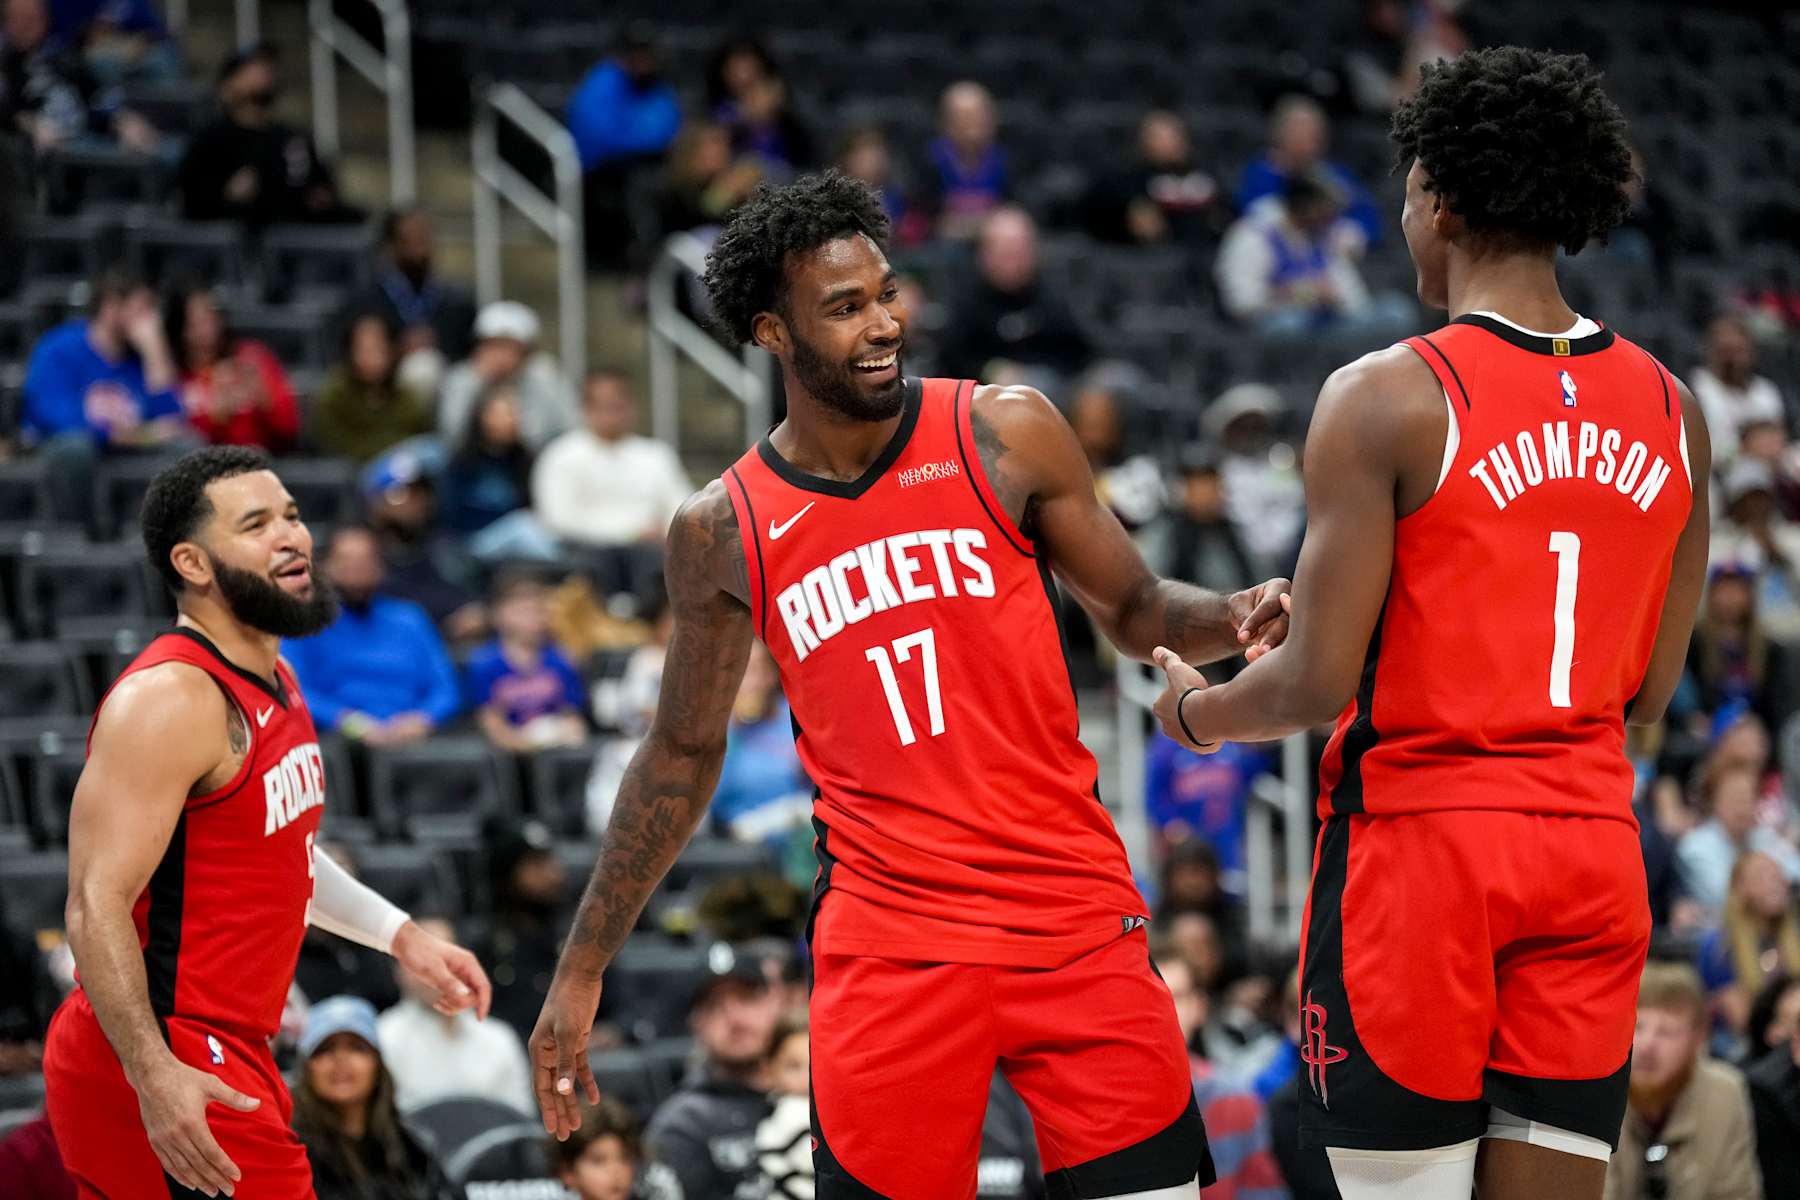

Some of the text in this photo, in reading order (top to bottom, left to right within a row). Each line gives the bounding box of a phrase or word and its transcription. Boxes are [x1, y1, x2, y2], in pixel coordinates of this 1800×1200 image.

[898, 459, 958, 480] MEMORIAL
[900, 465, 959, 488] HERMANN
[1468, 421, 1671, 512] THOMPSON
[776, 528, 996, 663] ROCKETS
[1549, 531, 1581, 707] 1
[865, 627, 945, 747] 17
